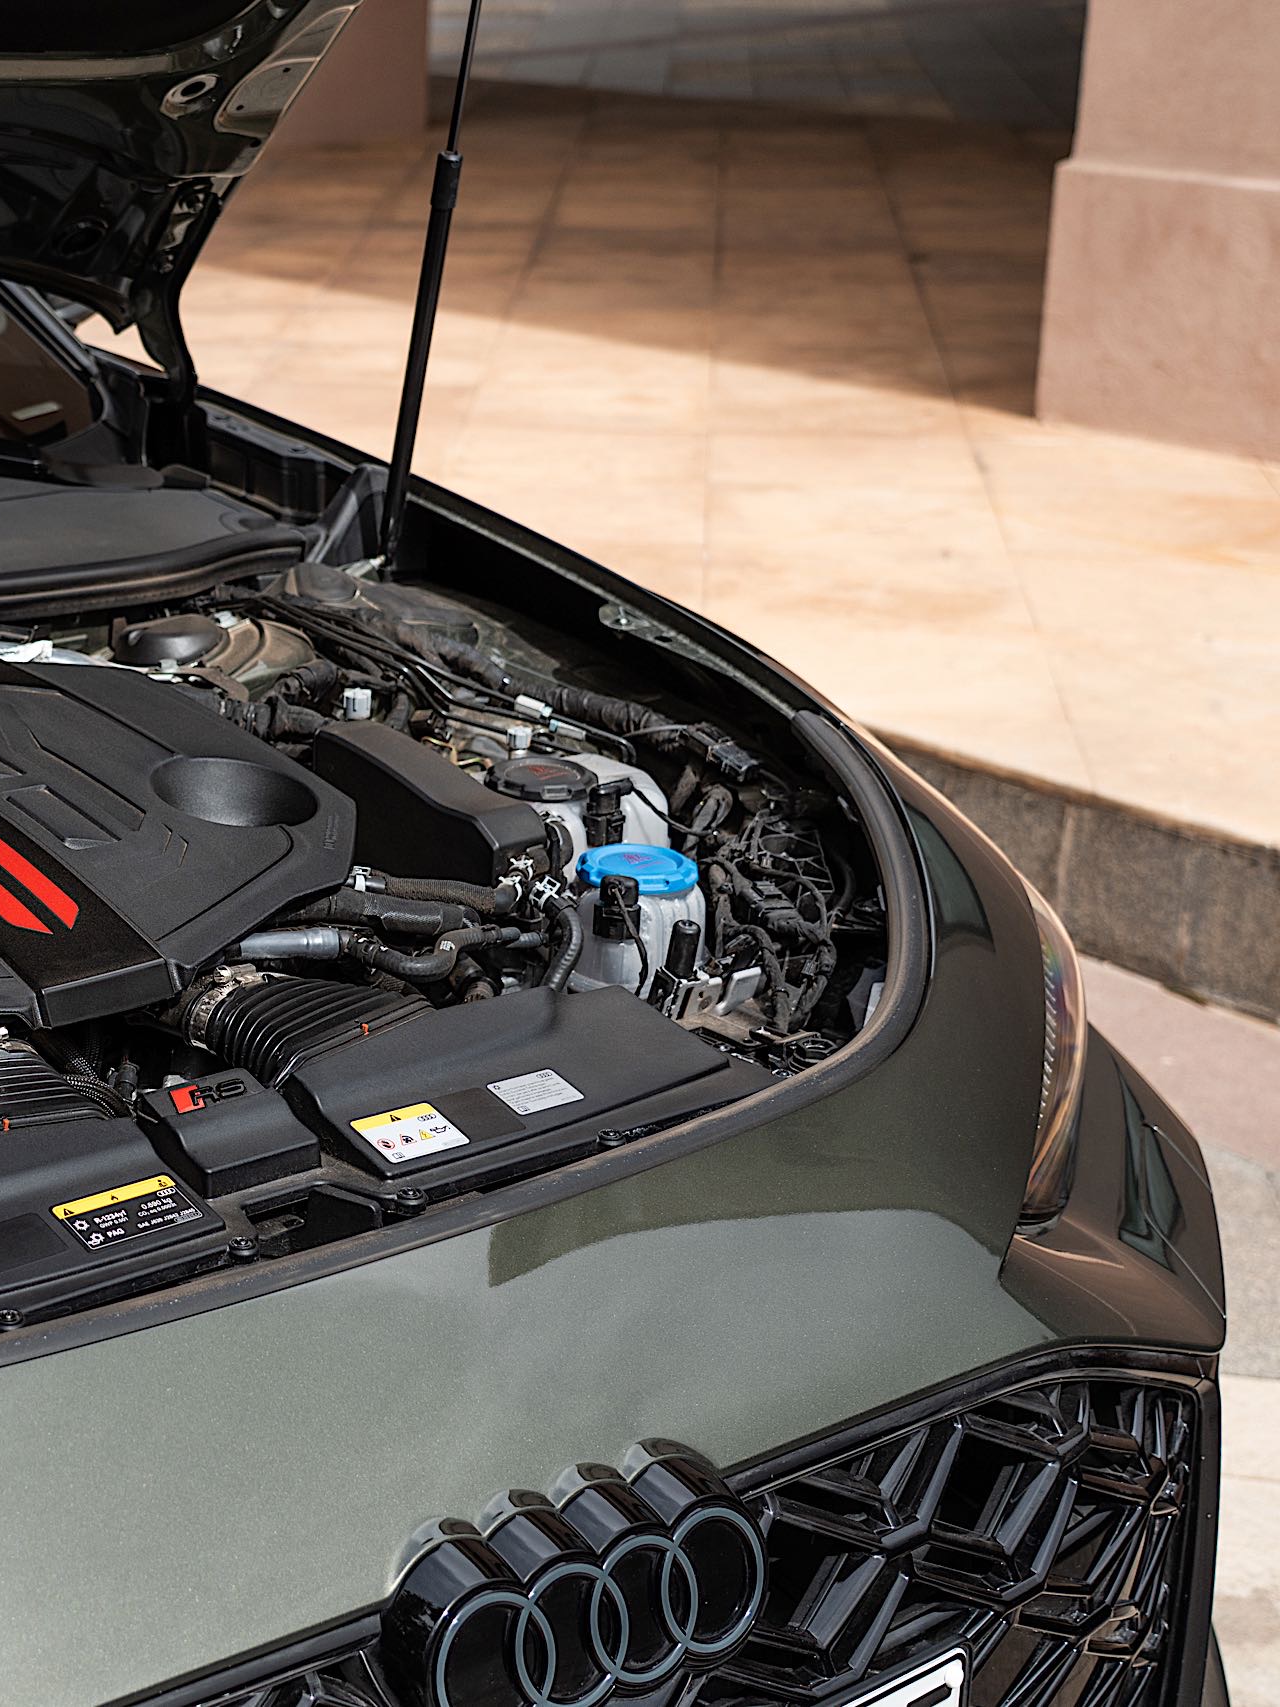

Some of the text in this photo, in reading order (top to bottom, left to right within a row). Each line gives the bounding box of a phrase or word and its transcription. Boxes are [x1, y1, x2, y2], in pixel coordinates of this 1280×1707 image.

[186, 1078, 247, 1107] RS
[93, 1209, 127, 1225] R-1234yf
[106, 1227, 126, 1238] PAG
